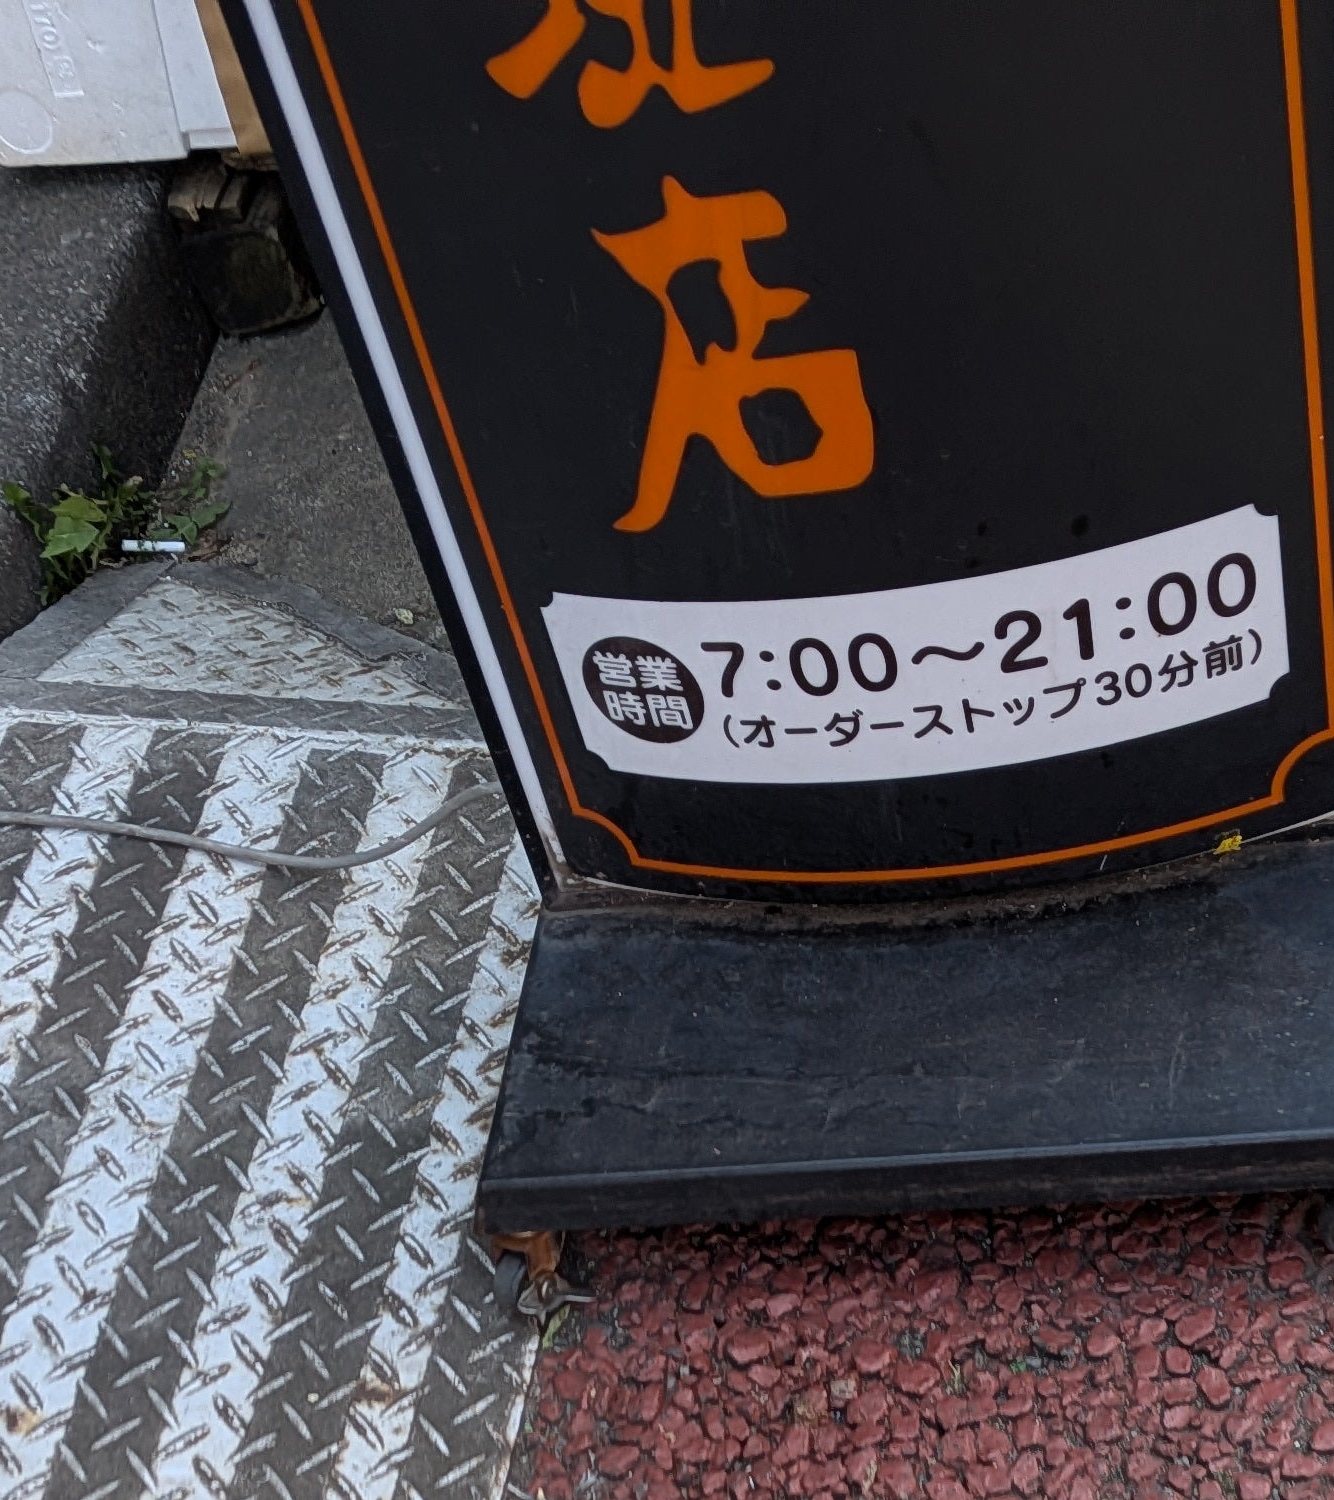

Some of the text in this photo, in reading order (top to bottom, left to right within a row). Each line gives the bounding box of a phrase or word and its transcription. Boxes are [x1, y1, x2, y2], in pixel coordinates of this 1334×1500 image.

[592, 650, 684, 692] 営業
[723, 627, 1264, 750] (オーダーストップ30分前)
[602, 690, 694, 730] 時間
